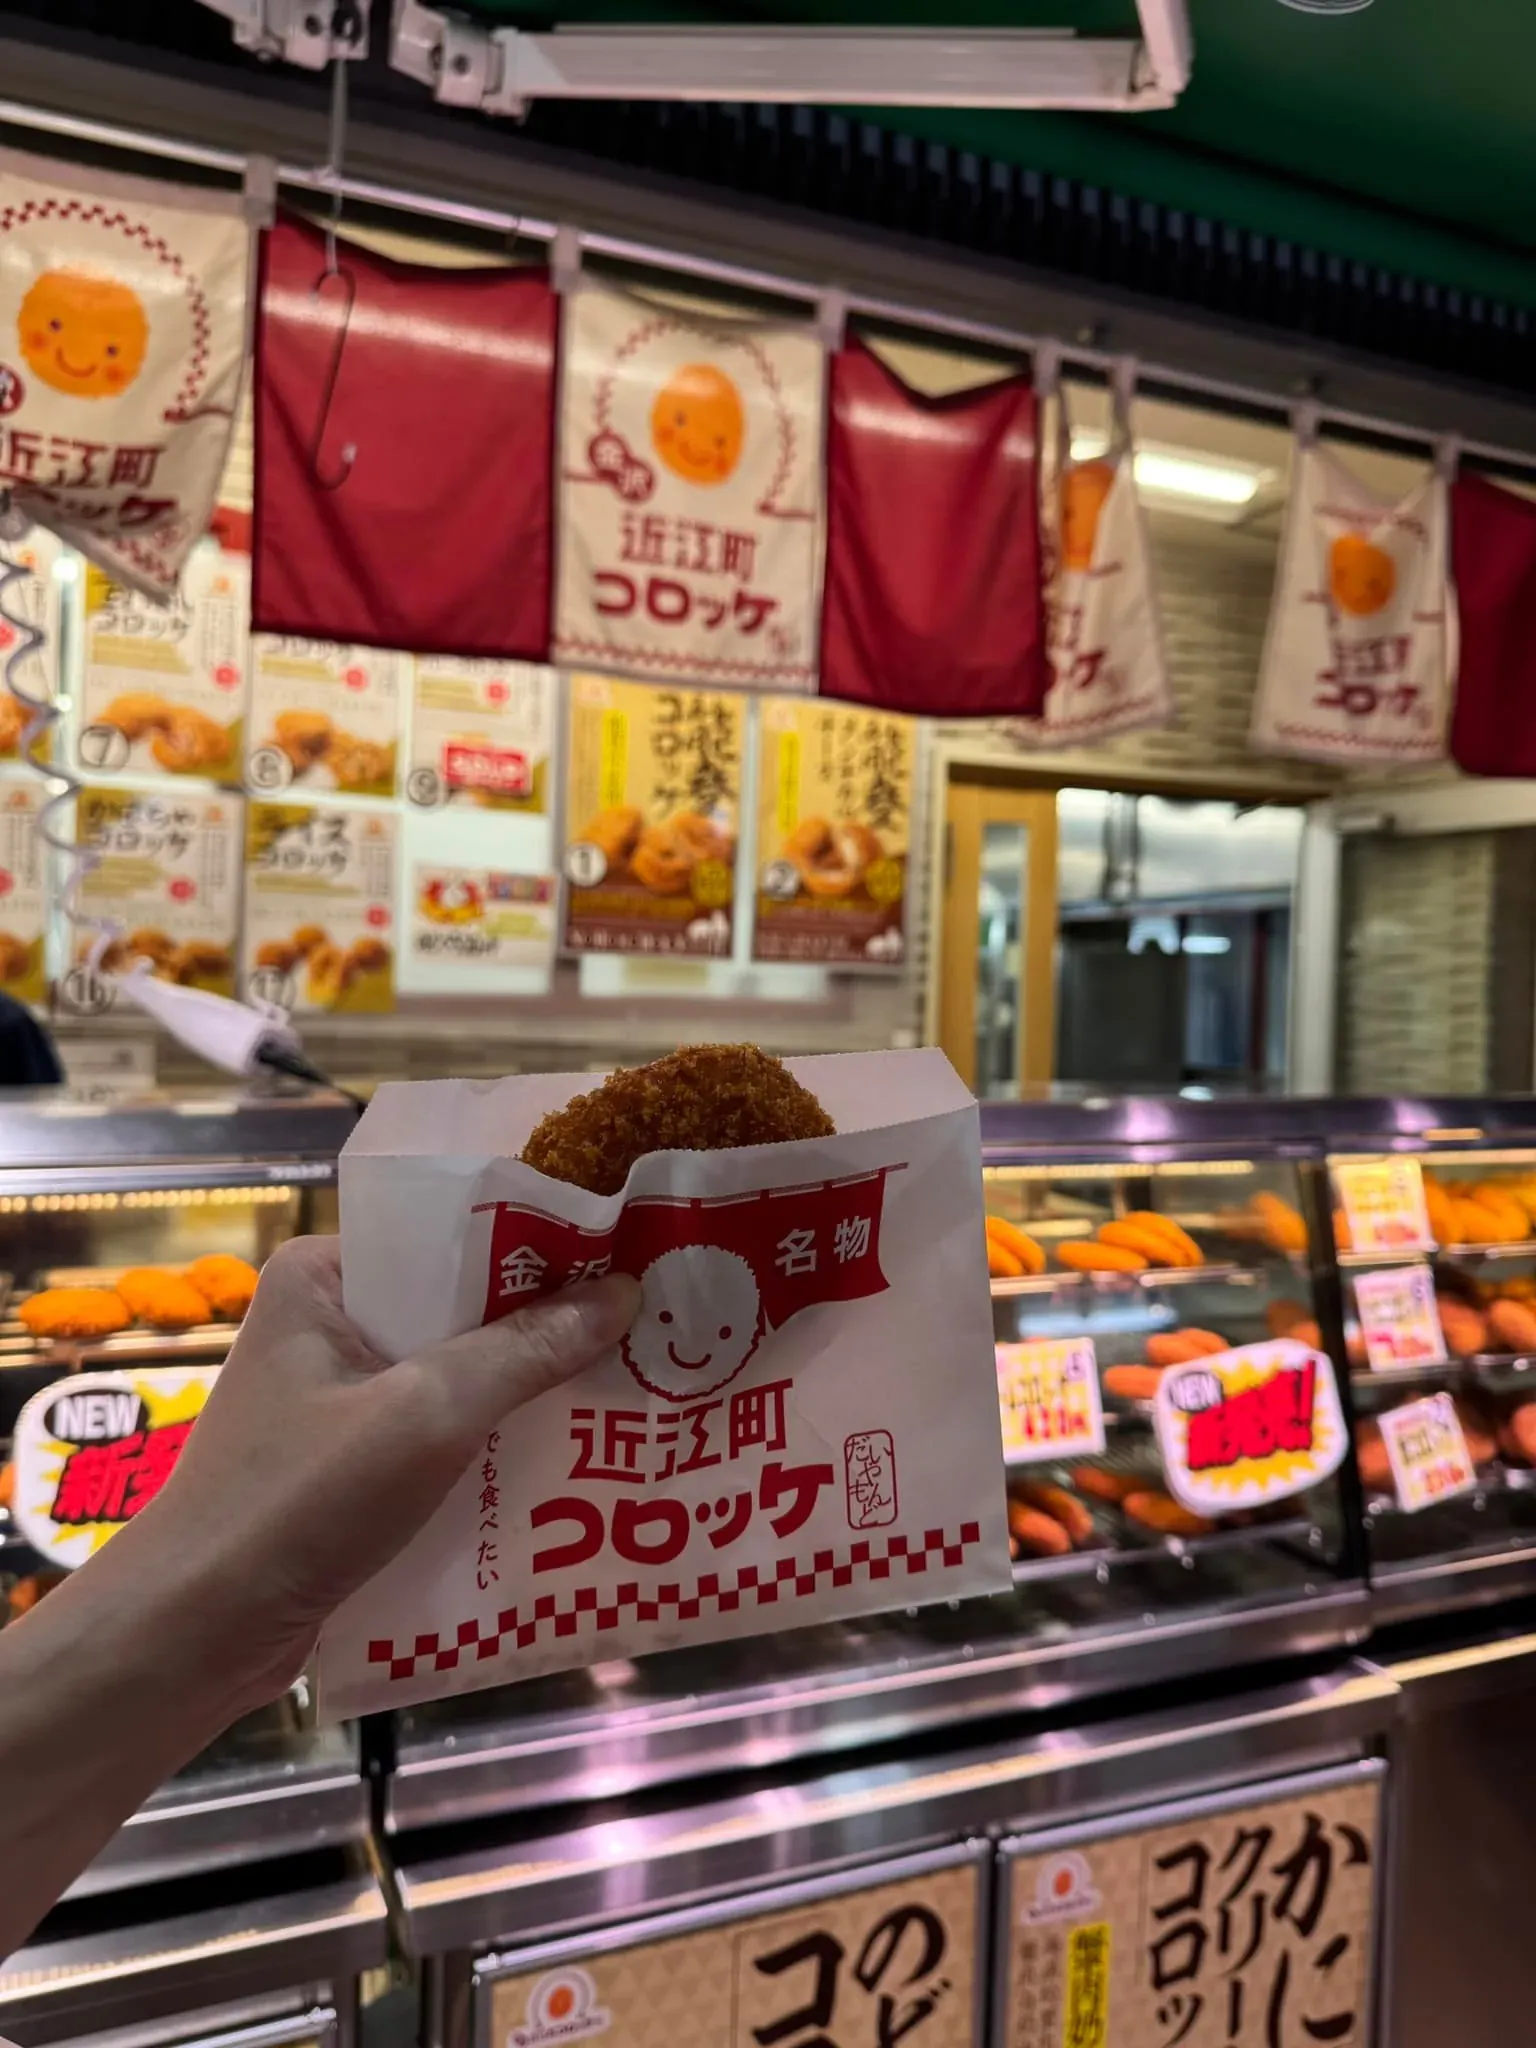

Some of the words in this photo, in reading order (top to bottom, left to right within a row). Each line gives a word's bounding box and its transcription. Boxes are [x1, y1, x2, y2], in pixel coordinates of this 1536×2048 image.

[620, 511, 757, 584] 近江町
[591, 570, 782, 635] コロッケ
[775, 1215, 871, 1276] 名物
[56, 1393, 141, 1440] NEW
[568, 1378, 794, 1484] 近江町
[530, 1462, 834, 1574] コロッケ
[752, 1930, 844, 2048] コ
